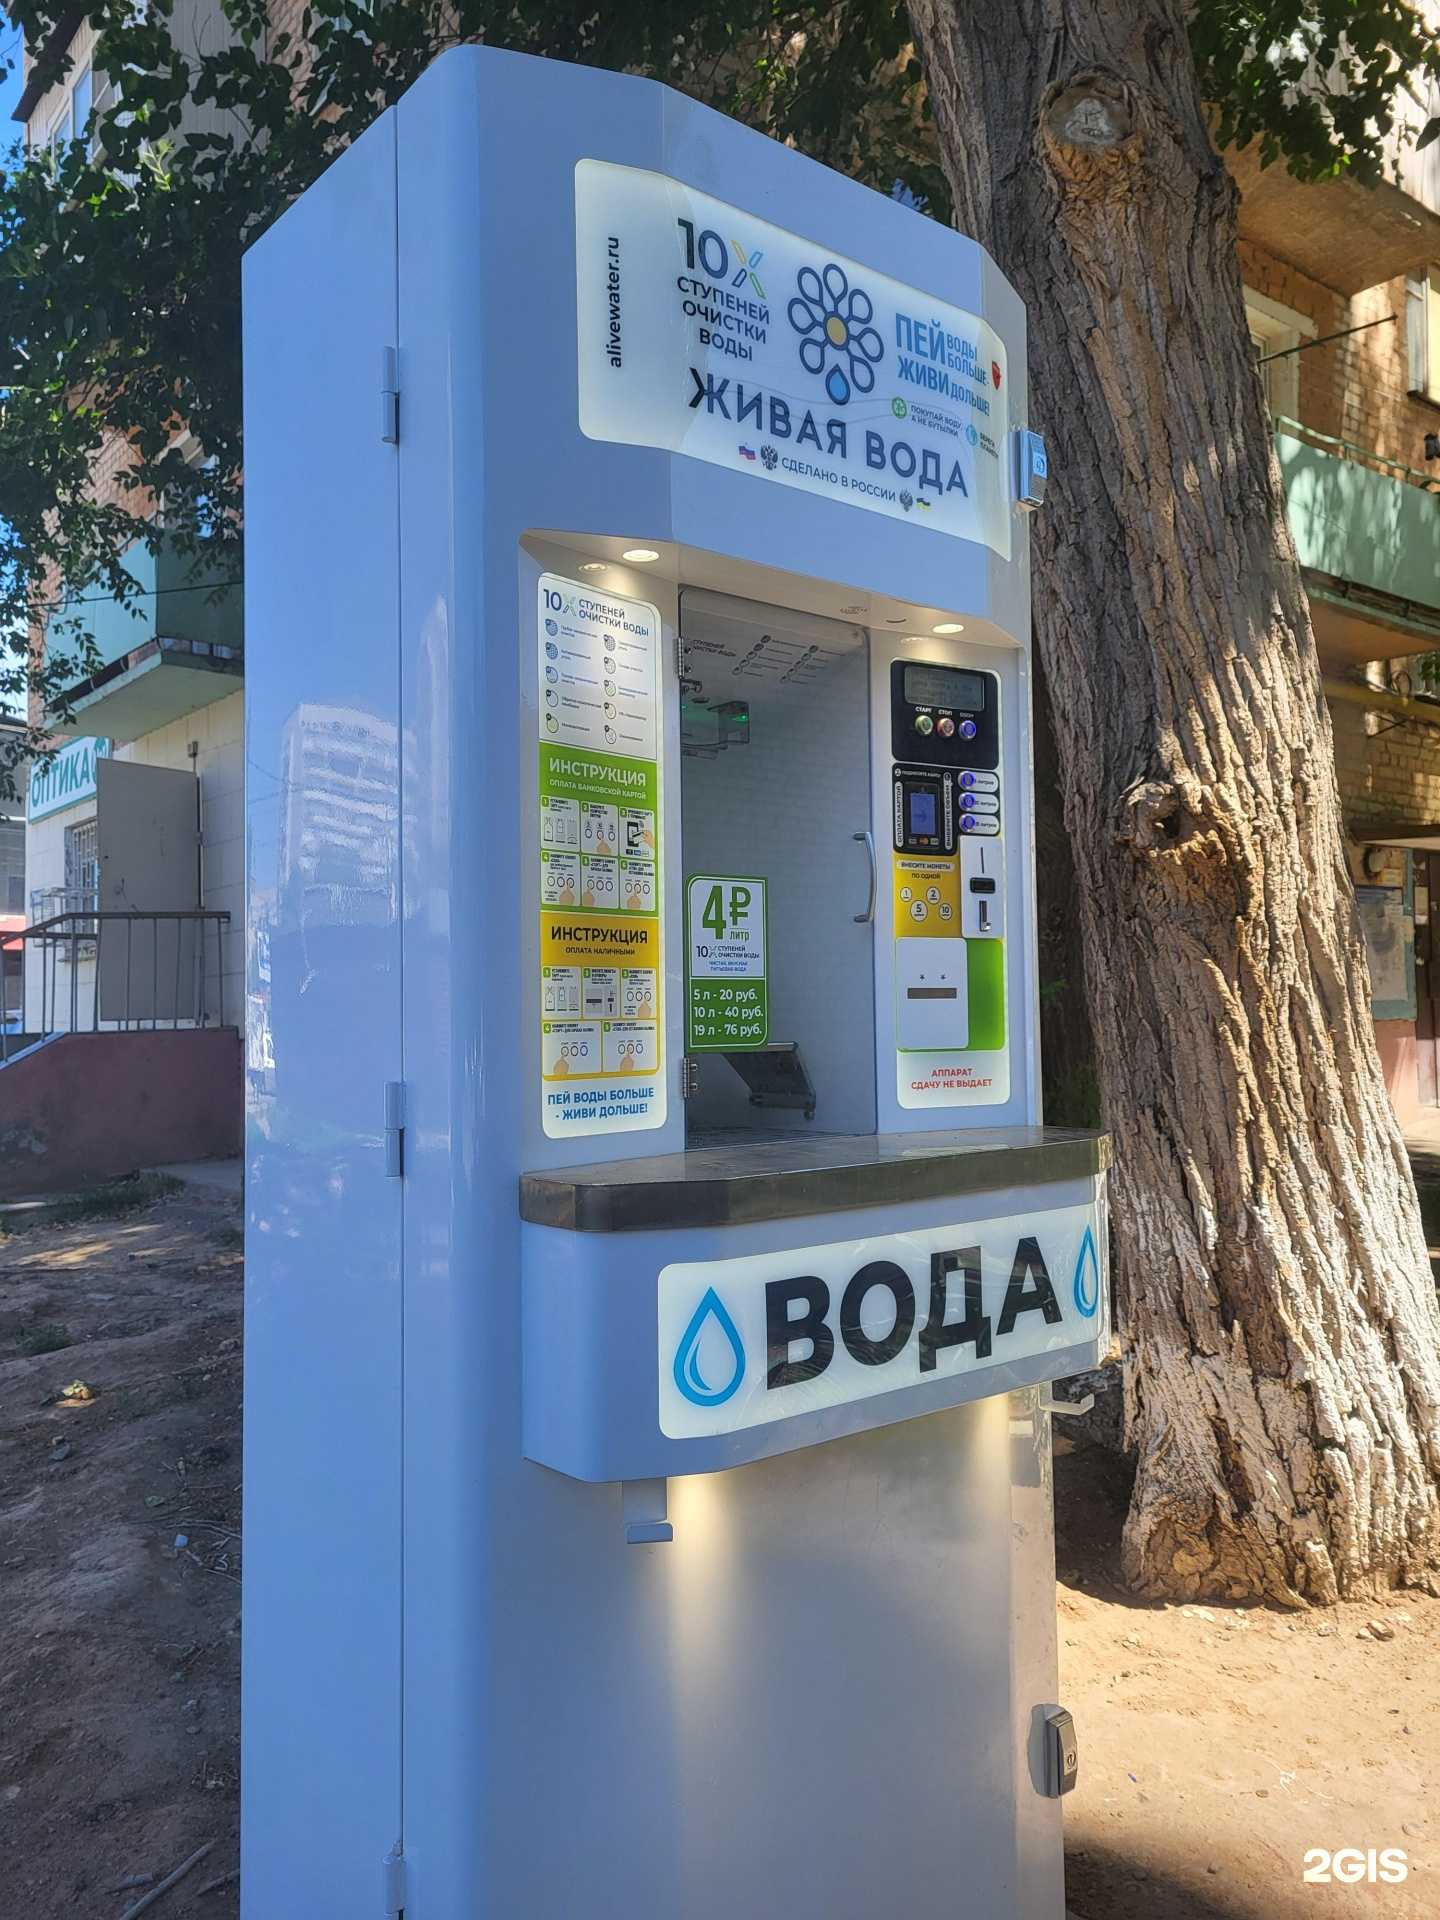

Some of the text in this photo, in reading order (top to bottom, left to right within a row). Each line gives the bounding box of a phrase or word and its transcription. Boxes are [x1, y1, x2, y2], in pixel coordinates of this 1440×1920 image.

[606, 237, 622, 368] alivewater.ru
[677, 276, 770, 324] СТУПЕНЕЙ
[683, 300, 767, 344] ОЧИСТКИ
[700, 328, 753, 361] ВОДЫ
[895, 312, 978, 365] ПЕЙ ВОДЫ
[897, 355, 950, 397] ЖИВИ
[689, 367, 969, 498] ЖИВАЯ ВОДА
[781, 457, 896, 502] СДЕЛАНО В РОССИИ
[579, 598, 625, 620] СТУПЕНЕЙ
[579, 609, 649, 638] ОЧИСТКИ ВОДЫ
[549, 757, 647, 787] ИНСТРУКЦИЯ
[550, 779, 647, 801] ОПЛАТА БАНКОВСКОЙ КАРТОЙ
[921, 872, 940, 880] ОДНОЙ
[941, 906, 950, 914] 10
[551, 926, 648, 945] ИНСТРУКЦИЯ
[593, 948, 635, 956] НАЛИЧНЫМИ
[694, 989, 700, 1000] 5
[703, 992, 710, 1000] л
[719, 990, 733, 1000] 20
[735, 989, 758, 1002] руб.
[694, 1007, 705, 1018] 10
[707, 1009, 715, 1018] л
[724, 1006, 739, 1018] 40
[741, 1006, 763, 1019] руб.
[694, 1025, 705, 1036] 19
[707, 1027, 715, 1036] л
[724, 1024, 738, 1035] 76
[740, 1023, 762, 1037] руб.
[932, 1068, 973, 1078] АППАРАТ
[911, 1079, 993, 1090] СДАЧУ НЕ ВЫДАЕТ
[548, 1087, 654, 1106] ПЕЙ ВОДЫ БОЛЬШЕ
[562, 1108, 597, 1121] ЖИВИ
[599, 1103, 648, 1118] ДОЛЬШЕ!
[765, 1236, 1063, 1391] ВОДА
